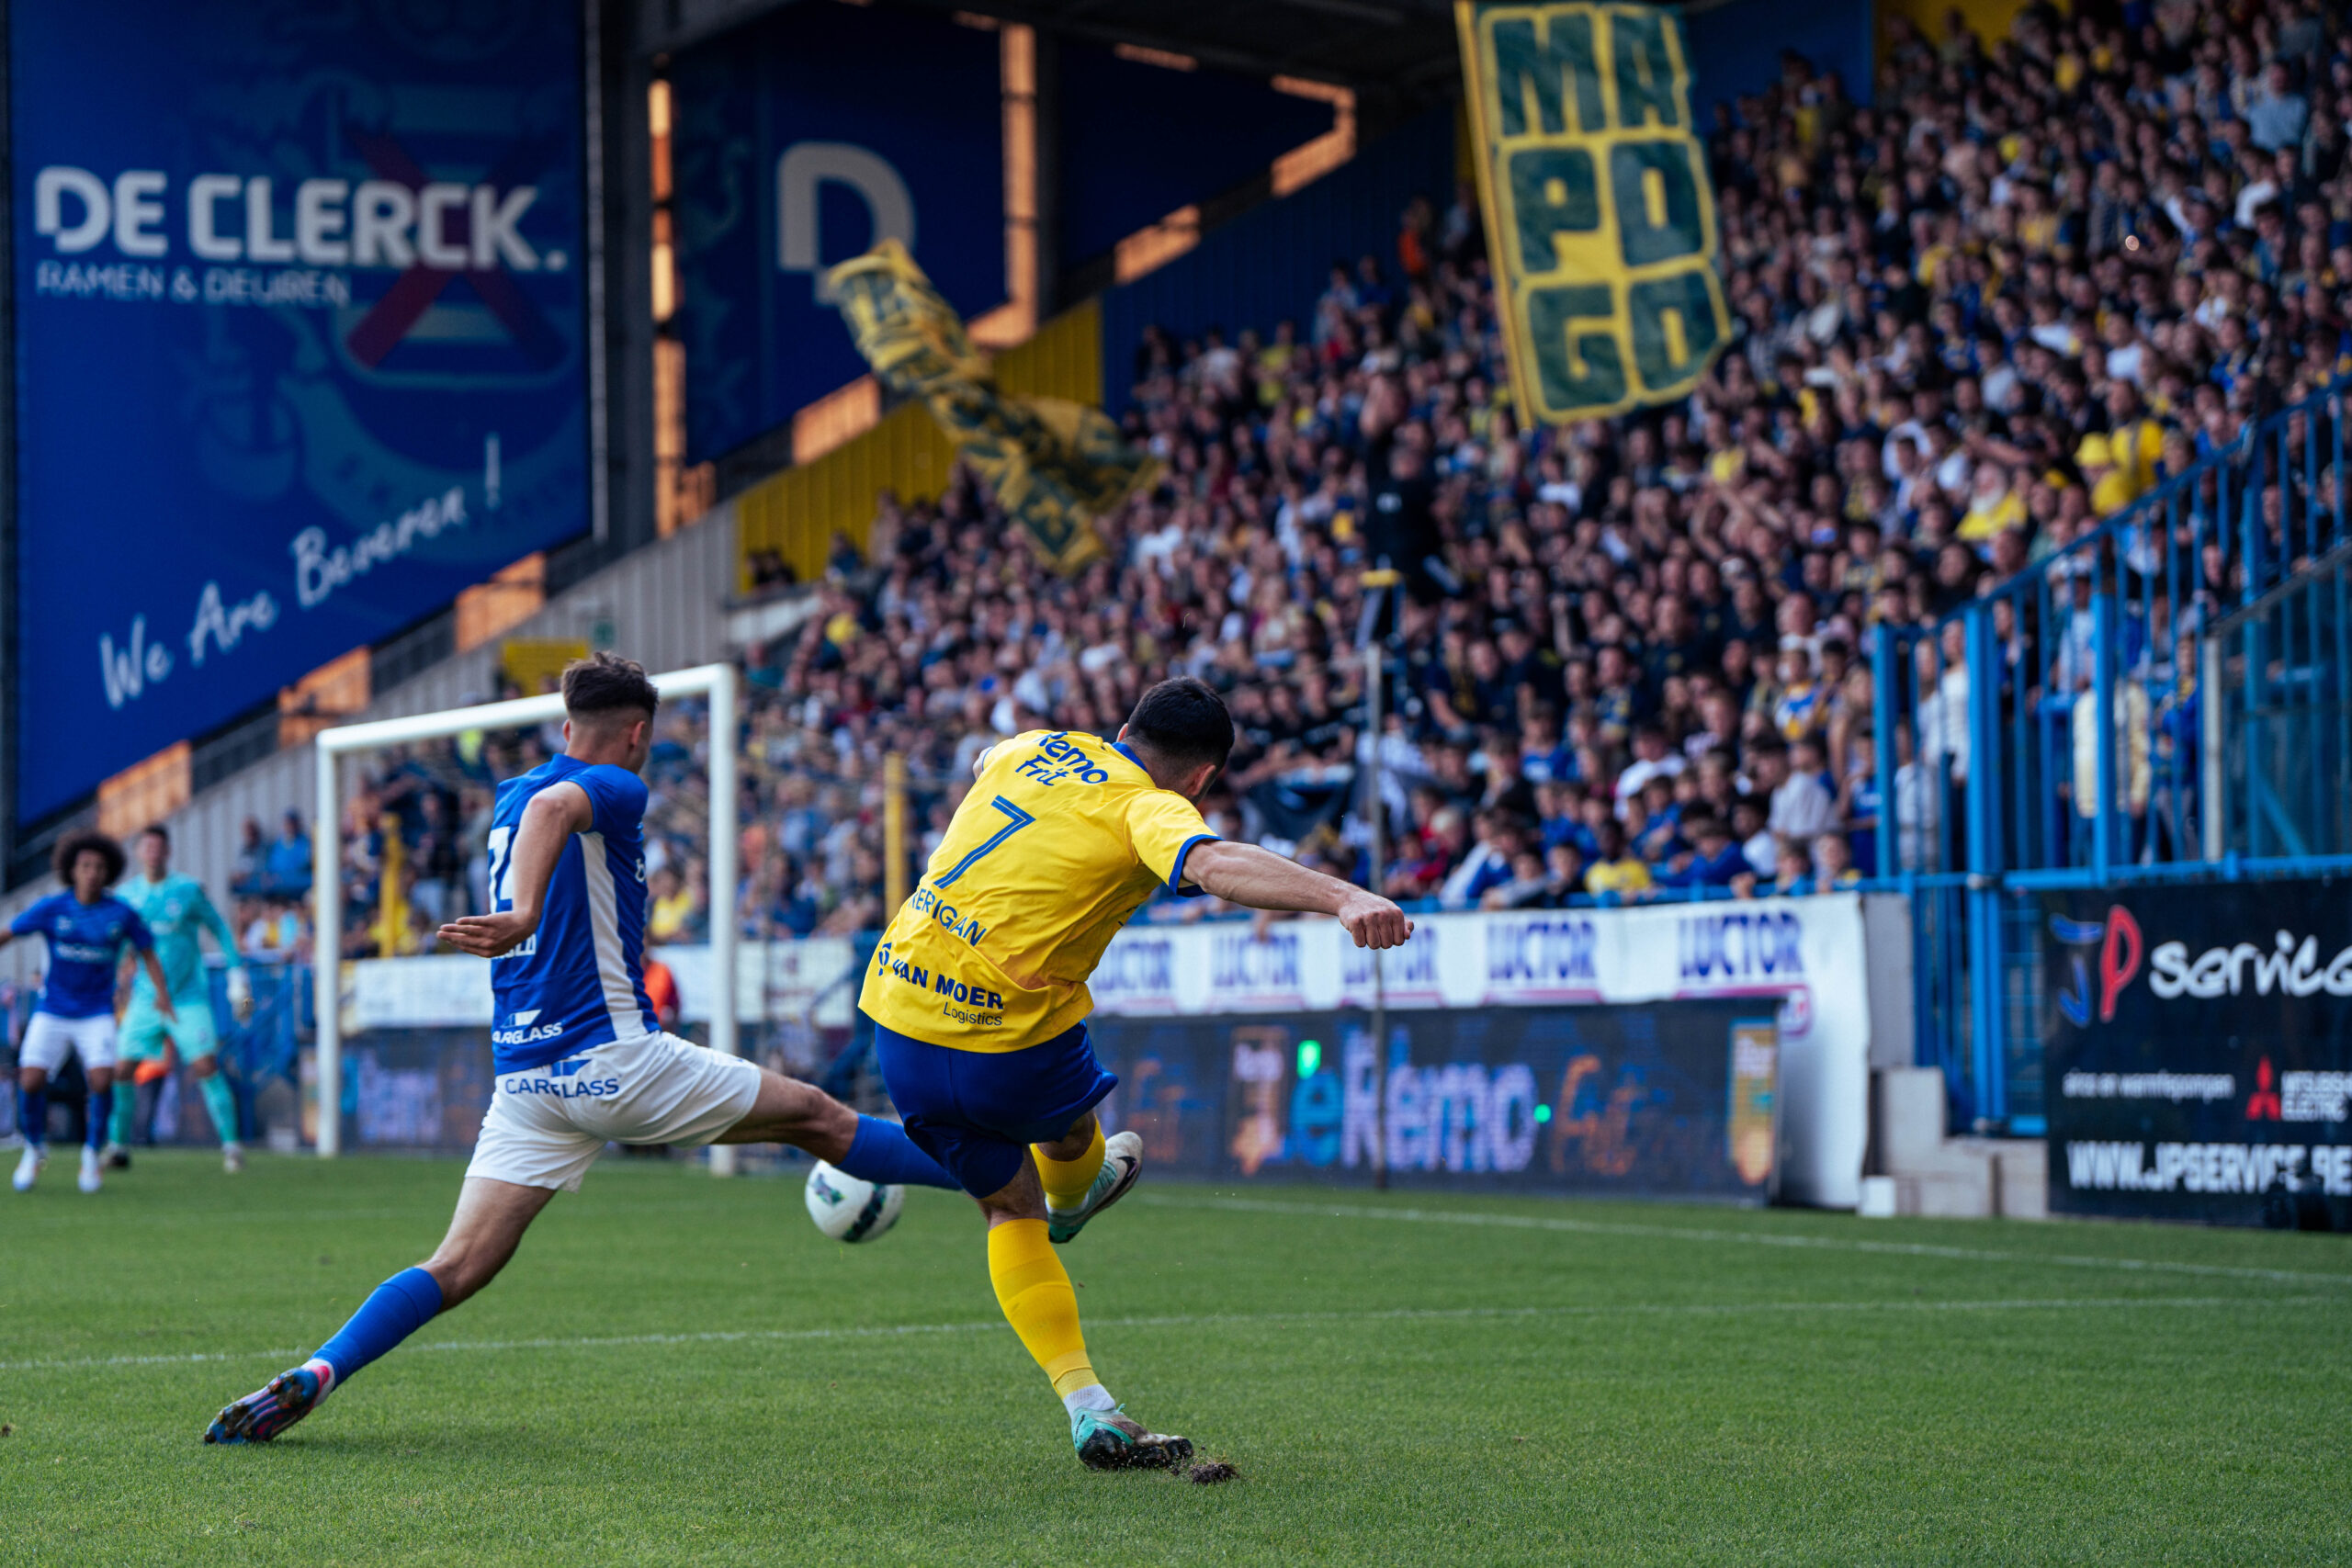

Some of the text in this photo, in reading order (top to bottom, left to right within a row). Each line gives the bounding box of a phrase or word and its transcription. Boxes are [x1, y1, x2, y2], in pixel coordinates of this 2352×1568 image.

[35, 165, 168, 257] DE
[99, 613, 174, 709] We
[188, 579, 279, 667] Are
[933, 795, 1036, 890] 7
[892, 958, 1004, 1010] VAN MOER
[492, 1021, 564, 1045] ARGLASS
[943, 1001, 1003, 1027] Logistics
[504, 1077, 620, 1099] CARGLASS
